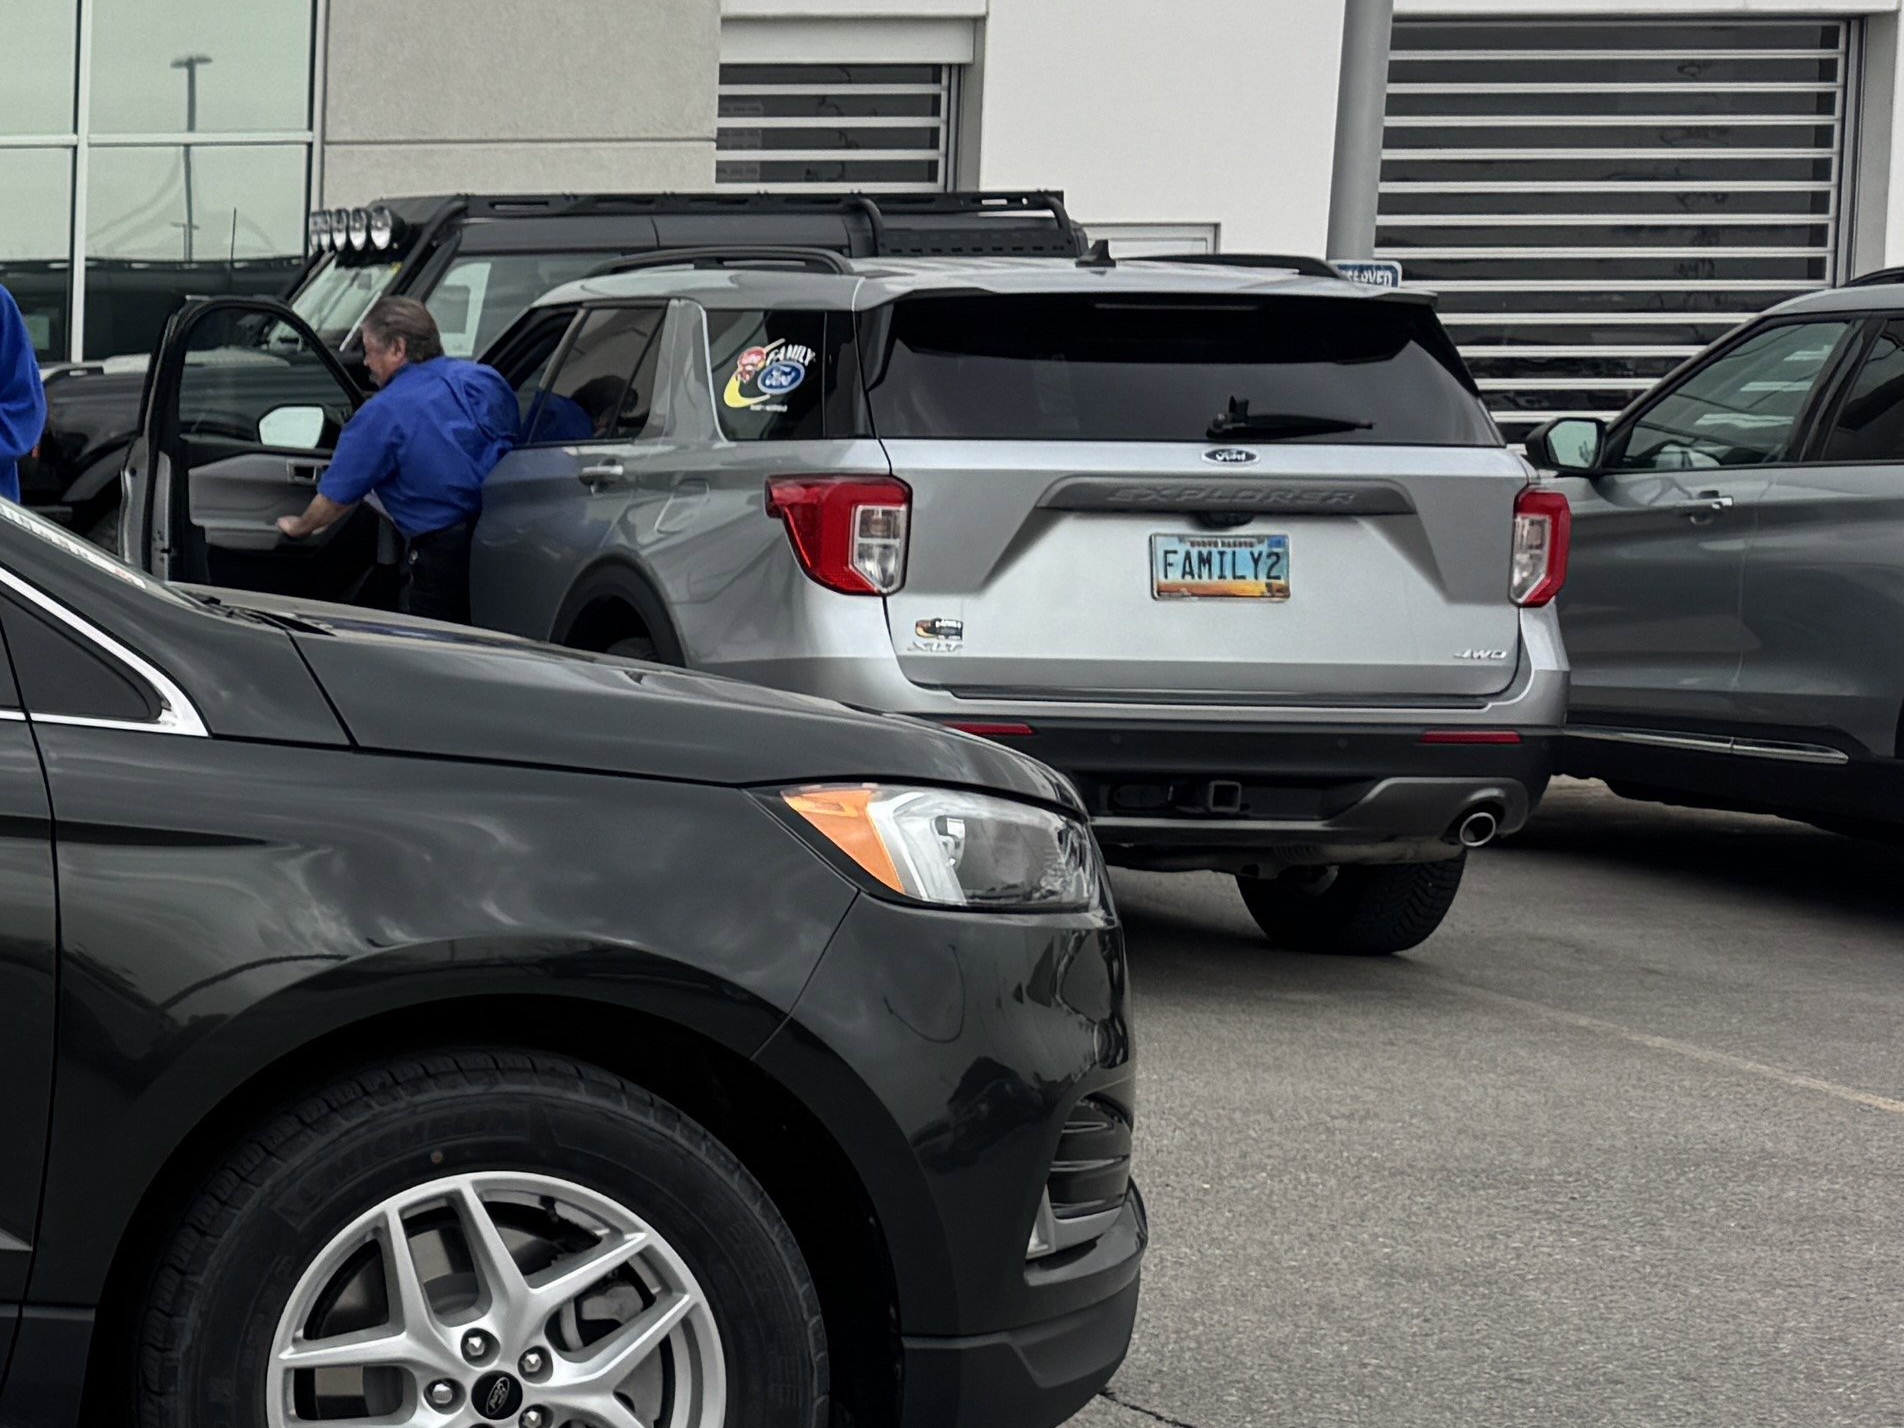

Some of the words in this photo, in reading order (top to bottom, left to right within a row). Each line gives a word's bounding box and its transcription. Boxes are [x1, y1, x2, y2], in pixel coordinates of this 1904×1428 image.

[766, 344, 816, 366] FAMILY
[765, 365, 797, 386] Ford
[1106, 487, 1357, 505] EXPLORER
[1163, 549, 1282, 581] FAMILY2
[1453, 648, 1507, 660] 4WD
